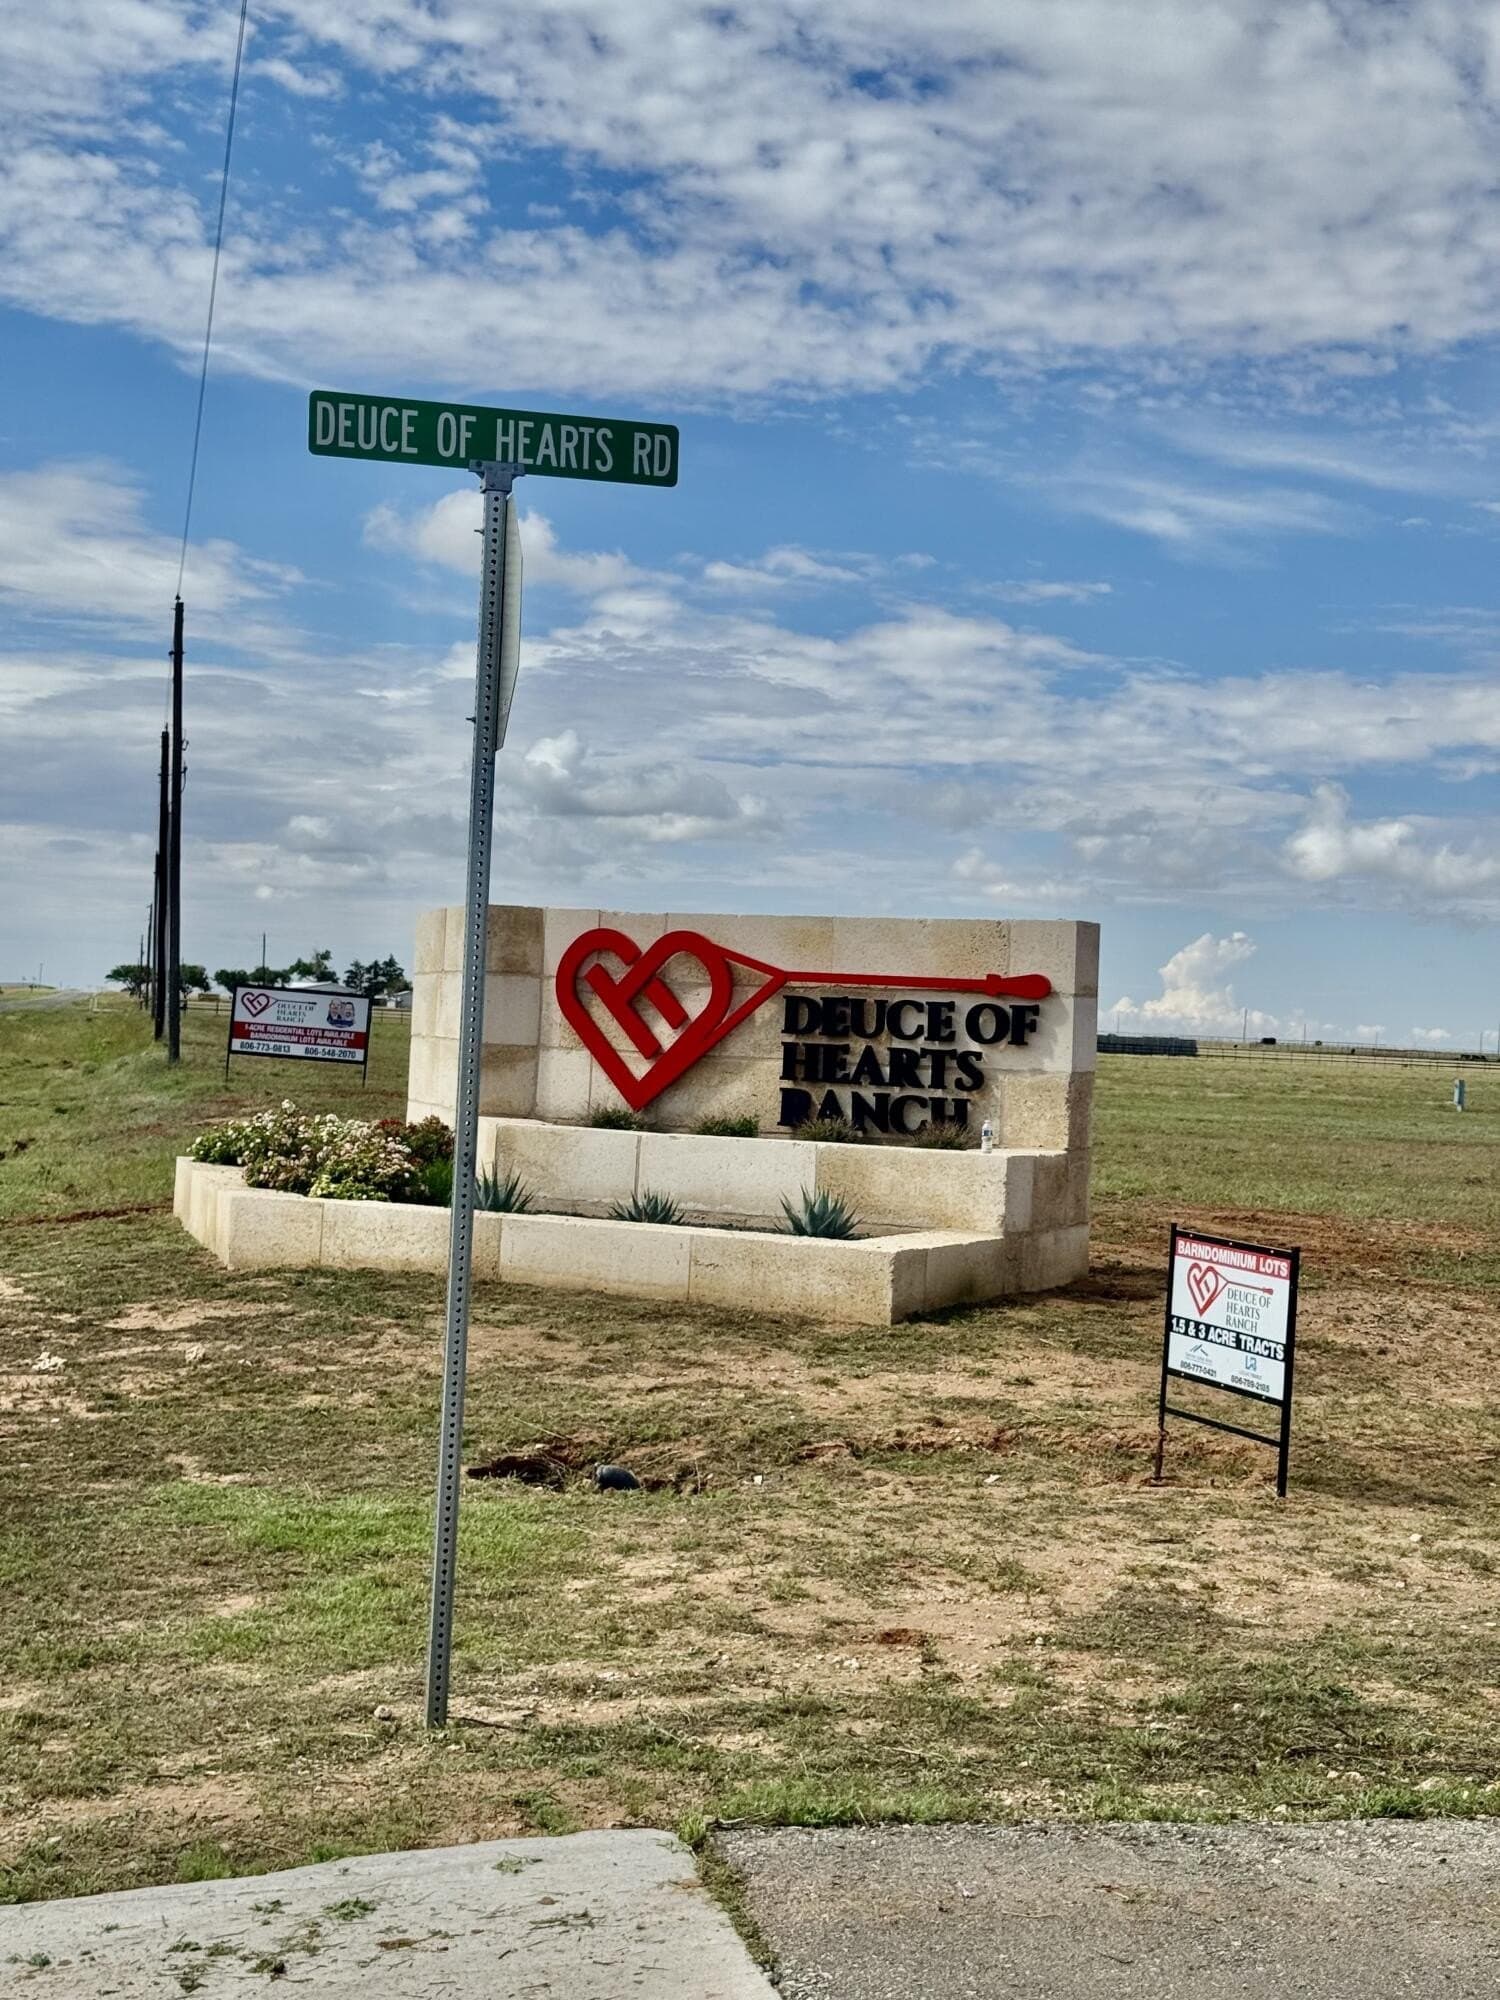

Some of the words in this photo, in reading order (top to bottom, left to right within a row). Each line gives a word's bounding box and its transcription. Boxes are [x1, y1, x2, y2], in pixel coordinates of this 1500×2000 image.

[315, 400, 418, 454] DEUCE
[436, 411, 477, 458] OF
[496, 418, 614, 472] HEARTS
[633, 432, 672, 477] RD
[267, 1026, 305, 1036] RESIDENTIAL
[307, 1029, 322, 1037] LOTS
[324, 1030, 355, 1040] AVAILABLE
[781, 994, 956, 1042] DEUCE
[965, 1003, 1040, 1046] OF
[250, 1032, 298, 1043] BARNDOMINIUM
[299, 1036, 315, 1044] LOTS
[316, 1037, 348, 1047] AVAILABLE
[779, 1041, 985, 1092] HEARTS
[777, 1087, 971, 1135] RANCH
[1177, 1240, 1257, 1270] BARNDOMINIUM
[1259, 1258, 1289, 1277] LOTS
[1226, 1302, 1260, 1321] HEARTS
[1227, 1287, 1257, 1307] DEUCE
[1259, 1295, 1272, 1309] OF
[1172, 1317, 1186, 1334] 1.5
[1188, 1323, 1196, 1337] &
[1198, 1326, 1206, 1339] 3
[1208, 1328, 1237, 1347] ACRE
[1239, 1336, 1285, 1361] TRACTS
[1225, 1315, 1258, 1333] RANCH
